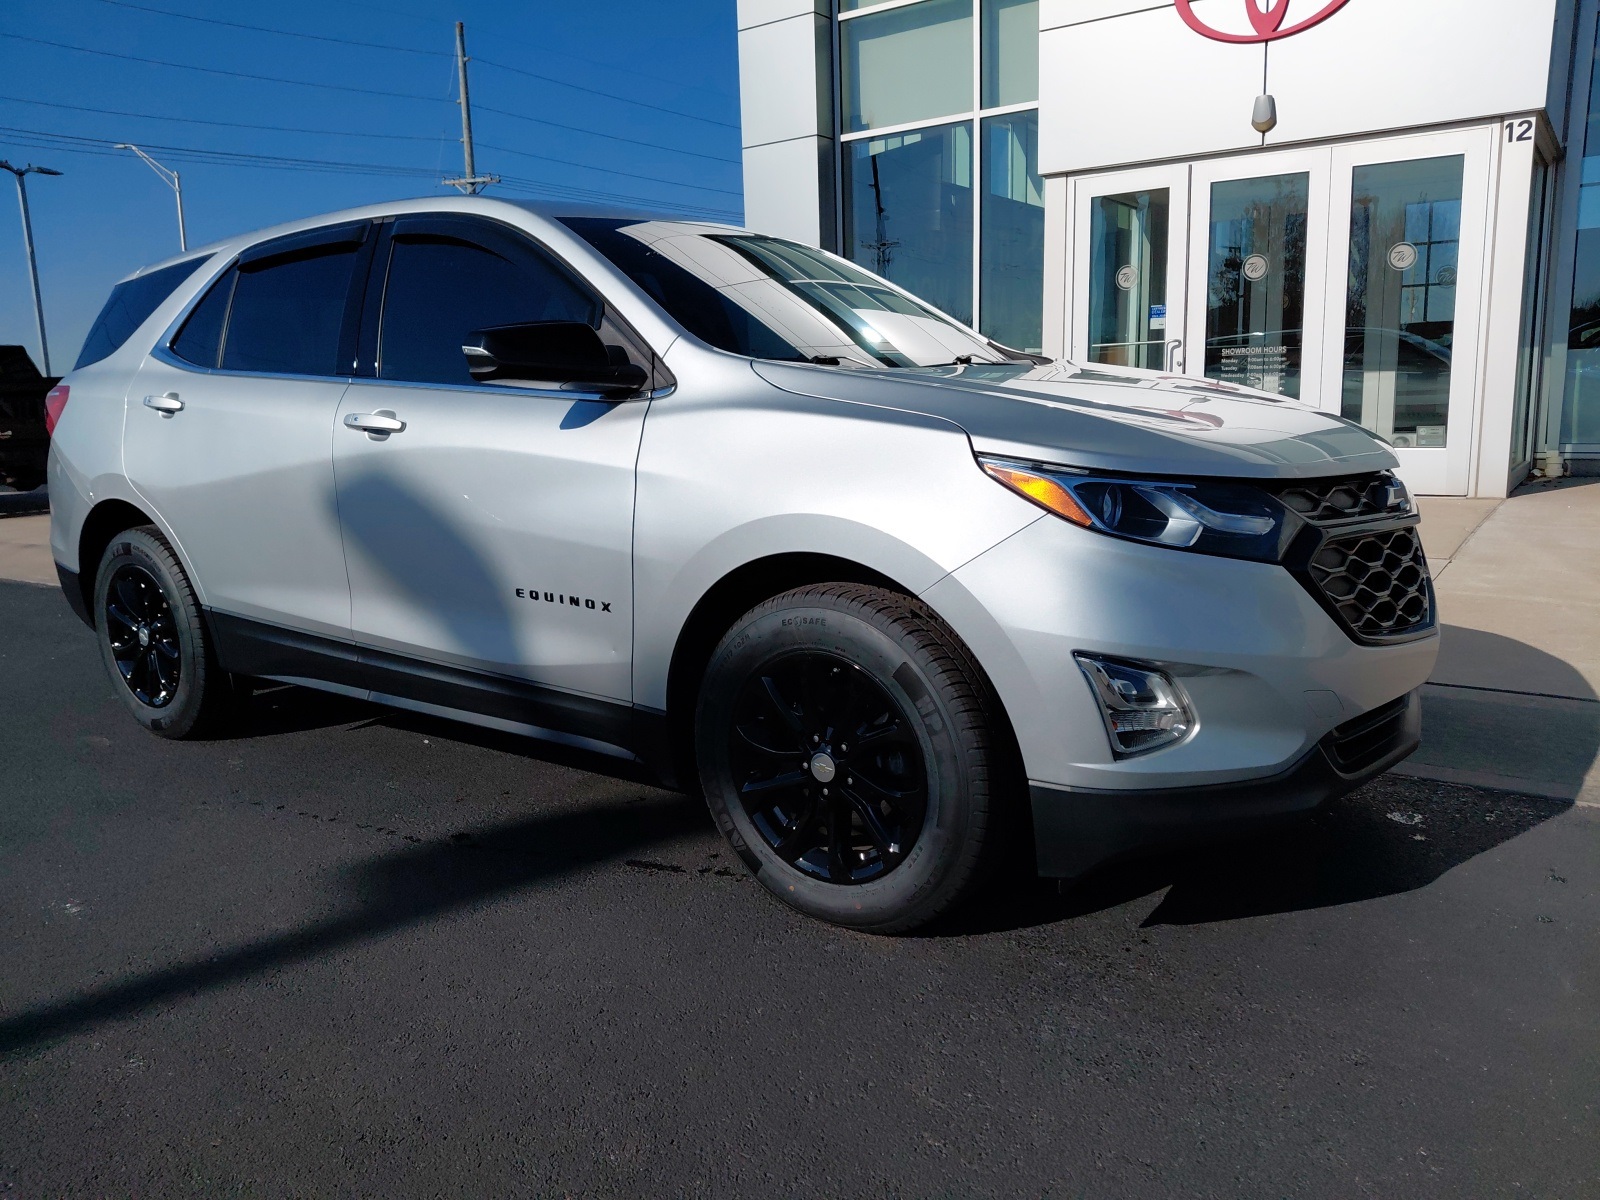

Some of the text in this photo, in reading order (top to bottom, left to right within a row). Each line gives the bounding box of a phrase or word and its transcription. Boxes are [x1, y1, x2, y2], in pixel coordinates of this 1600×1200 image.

[1505, 119, 1533, 143] 12
[1221, 347, 1262, 355] SHOWROOM
[515, 588, 612, 613] EQUINOX
